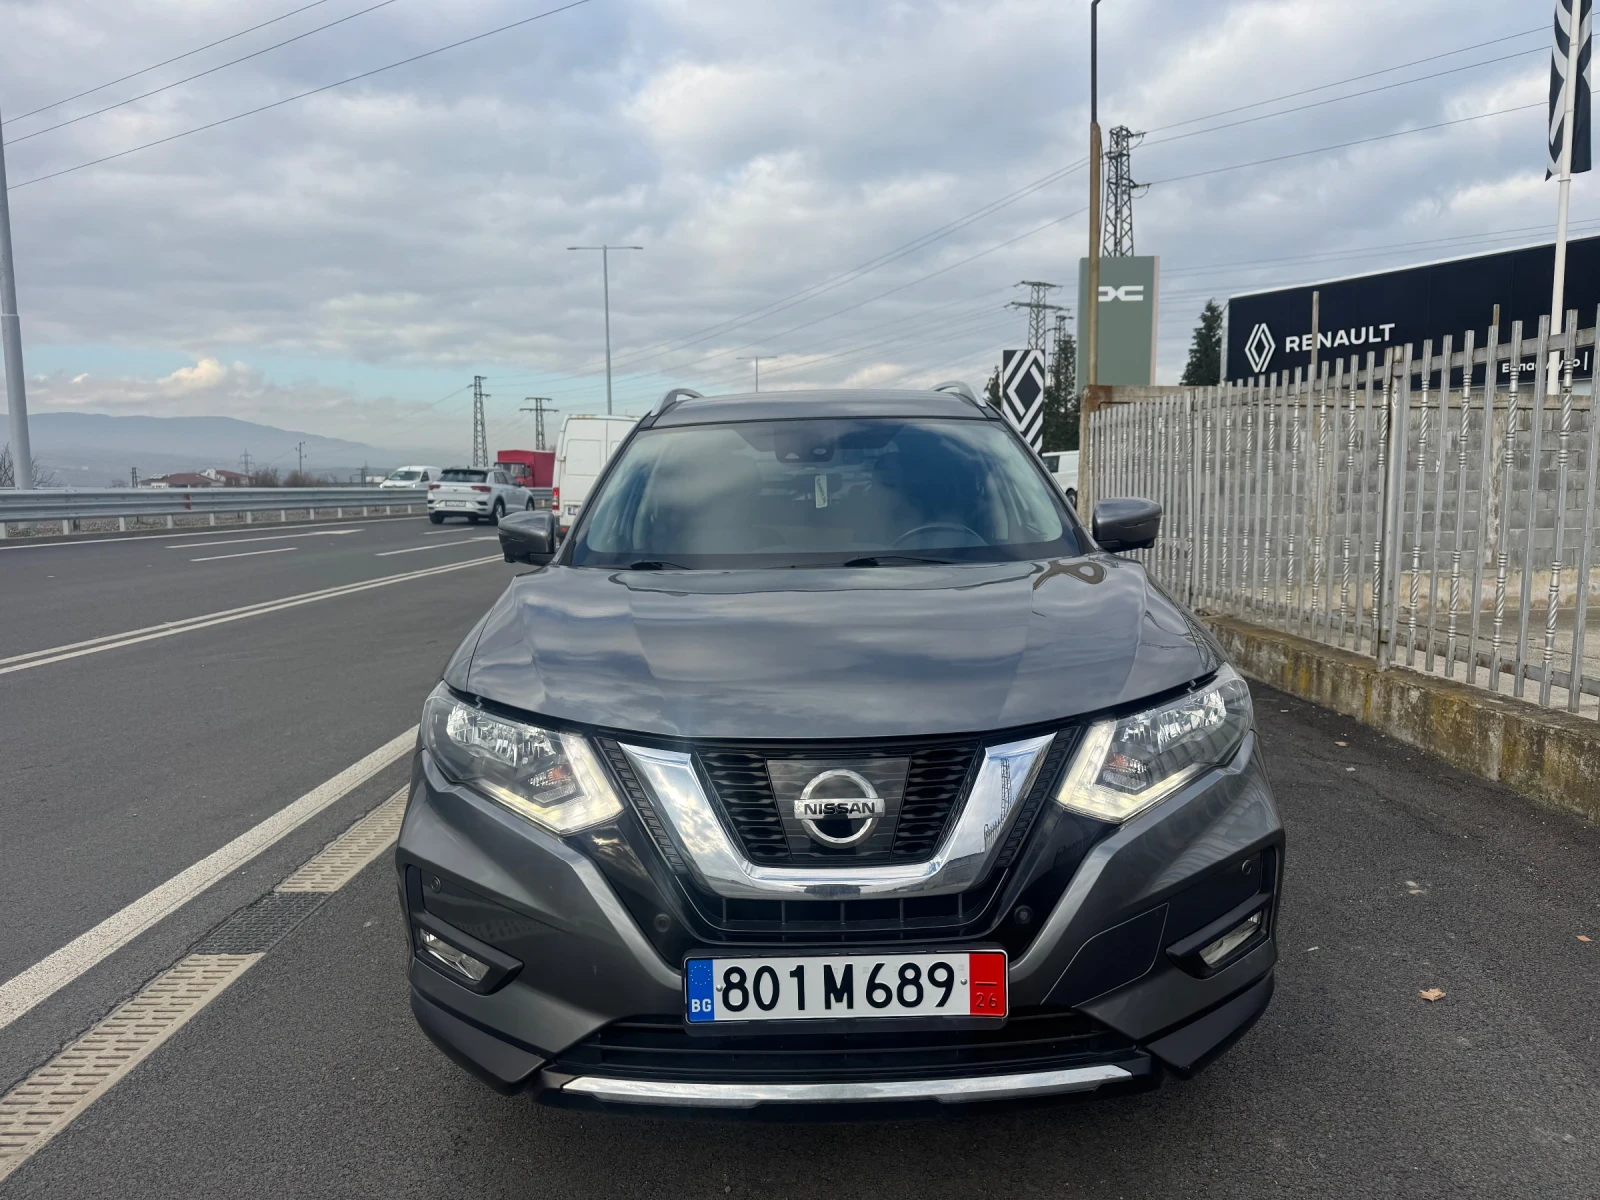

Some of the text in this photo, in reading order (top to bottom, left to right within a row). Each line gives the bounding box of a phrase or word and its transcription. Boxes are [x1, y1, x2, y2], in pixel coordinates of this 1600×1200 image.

[1285, 323, 1396, 353] RENAULT
[804, 802, 875, 815] NISSAN
[691, 998, 712, 1013] BG
[975, 992, 998, 1008] 26
